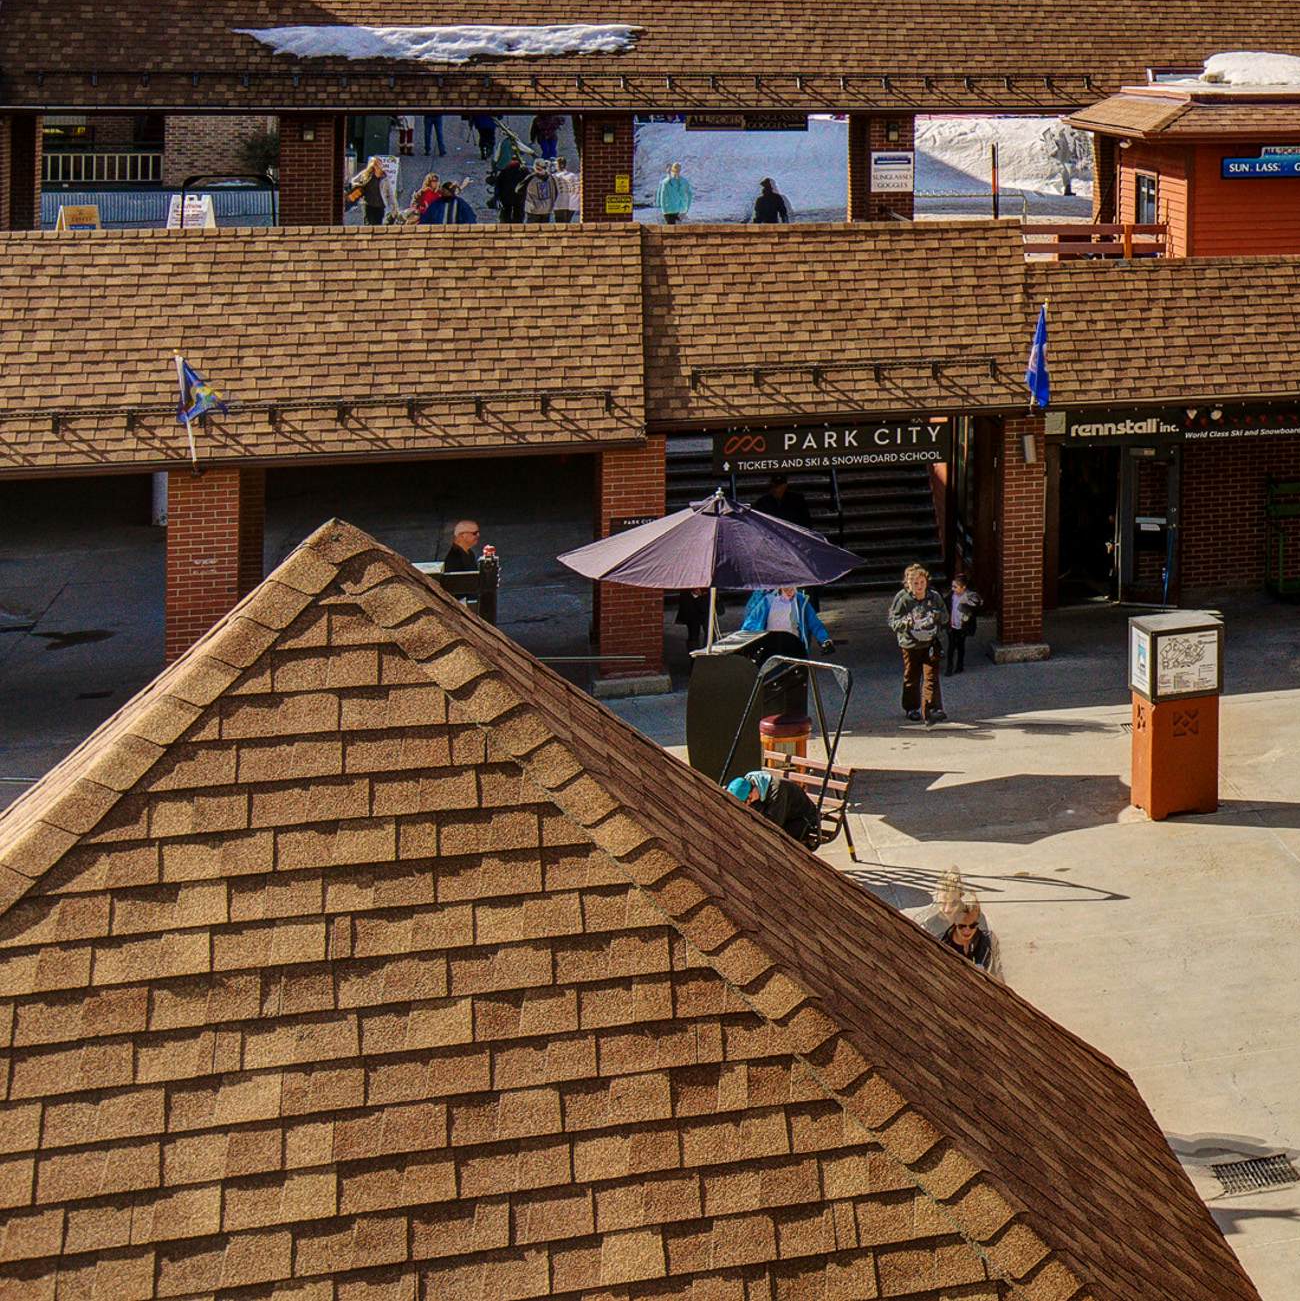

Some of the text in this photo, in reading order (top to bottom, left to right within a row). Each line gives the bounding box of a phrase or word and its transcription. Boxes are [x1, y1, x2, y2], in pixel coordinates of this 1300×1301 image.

[1070, 418, 1180, 437] rennstall inc.
[1185, 431, 1207, 439] World
[1230, 429, 1242, 437] Ski
[784, 426, 941, 450] PARK CITY
[738, 450, 942, 471] TICKETS AND SKI & SNOWBOARD SCHOOL
